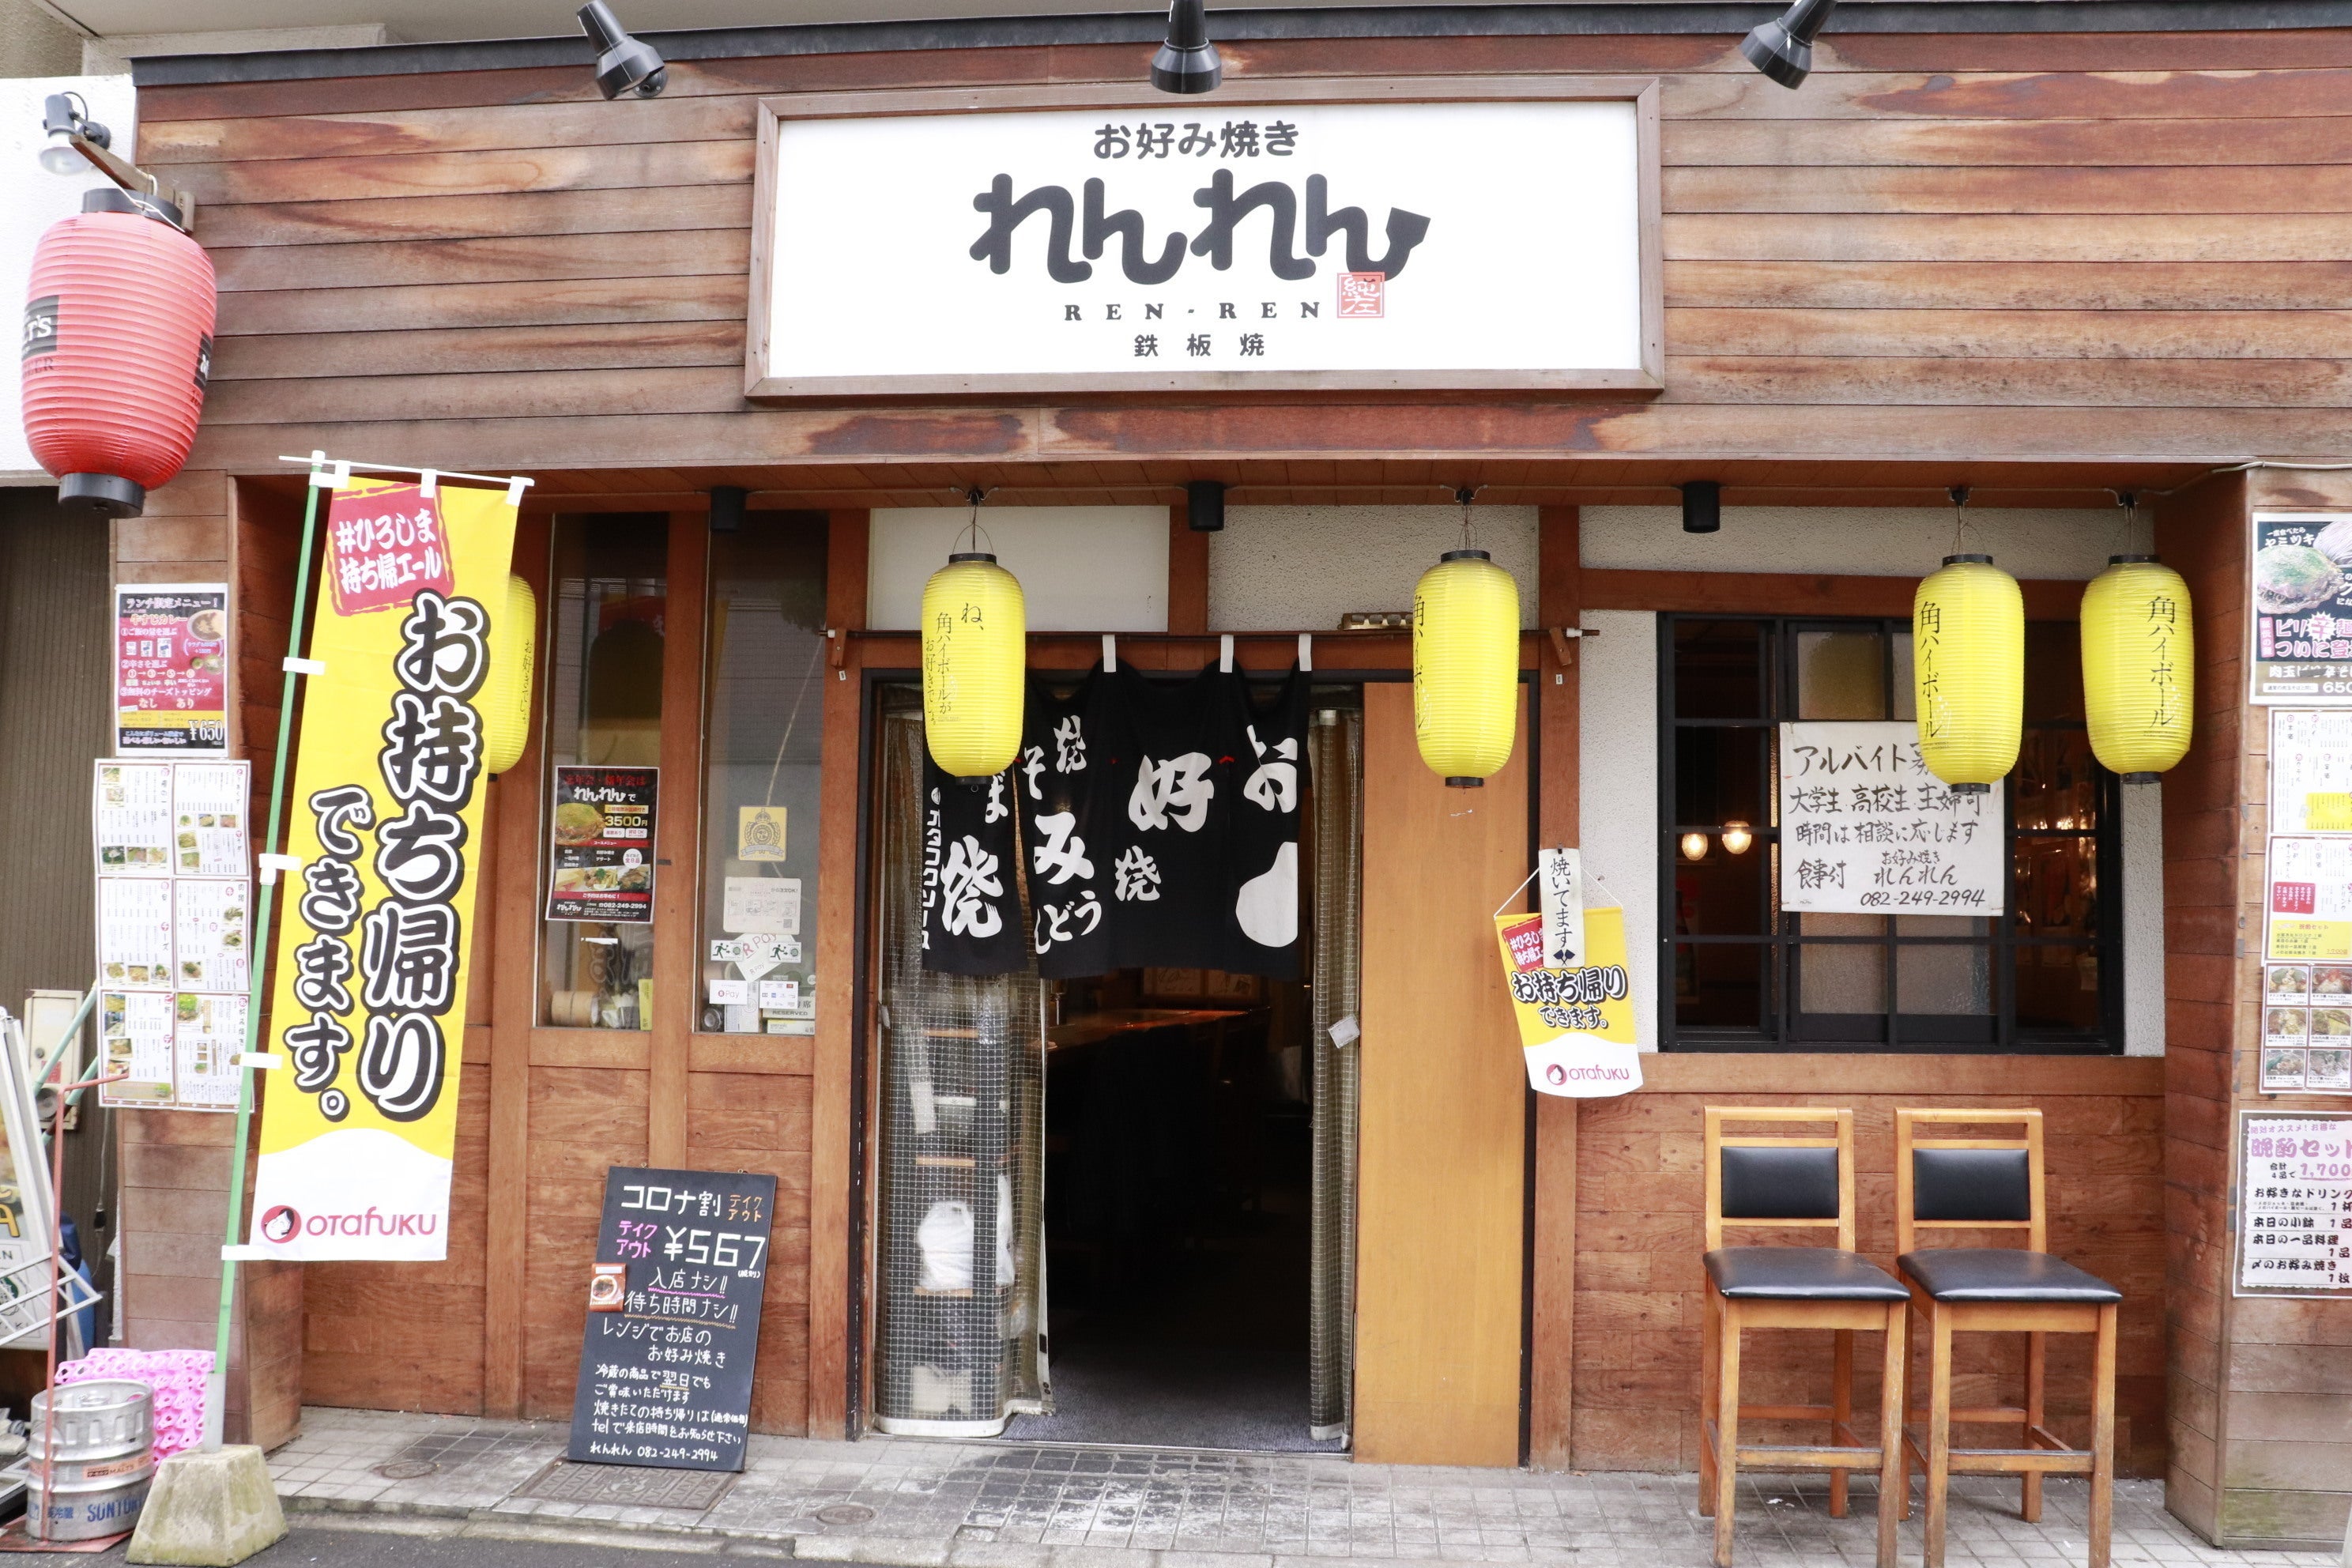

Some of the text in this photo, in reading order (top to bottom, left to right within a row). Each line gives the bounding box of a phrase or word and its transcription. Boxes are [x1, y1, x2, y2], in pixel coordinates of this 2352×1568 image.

[1094, 120, 1299, 160] お好み焼き
[969, 168, 1431, 286] れんれん
[1134, 333, 1265, 357] 鉄板焼
[336, 507, 436, 553] #ひろしま
[340, 546, 442, 594] 持ち帰エール
[2147, 595, 2177, 729] 角ハイボール
[2275, 640, 2352, 659] ついに登
[937, 612, 952, 714] 角ハイボールが
[1919, 600, 1943, 739] 角ハイボール
[605, 816, 648, 827] 3500円
[1796, 818, 1979, 846] 時間は相談に応じます
[356, 588, 491, 1123] お持ち帰り
[1882, 849, 1940, 866] お好み焼き
[1795, 858, 1847, 890] 食事付
[1874, 865, 1958, 888] れんれん
[1550, 857, 1573, 948] 焼いてます
[1860, 888, 1986, 907] 082-249-2994
[281, 782, 376, 1121] できます。
[1511, 965, 1629, 1004] お持ち帰り
[1538, 1004, 1608, 1029] できます。
[620, 1185, 721, 1217] コロナ割
[729, 1194, 763, 1210] テイク
[2255, 1187, 2352, 1199] お好きなドリンク
[728, 1209, 762, 1223] アウト
[618, 1219, 658, 1240] テイク
[2252, 1234, 2339, 1246] 本日の一品料理
[616, 1238, 652, 1259] アウト
[663, 1225, 767, 1270] ¥567
[603, 1317, 711, 1347] レンジでお店の
[647, 1344, 726, 1368] お好み焼き
[595, 1363, 711, 1389] 冷蔵の商品で翌日でも
[594, 1383, 690, 1404] ご賞味いただけます
[590, 1440, 718, 1462] れんれん 082-249-2994
